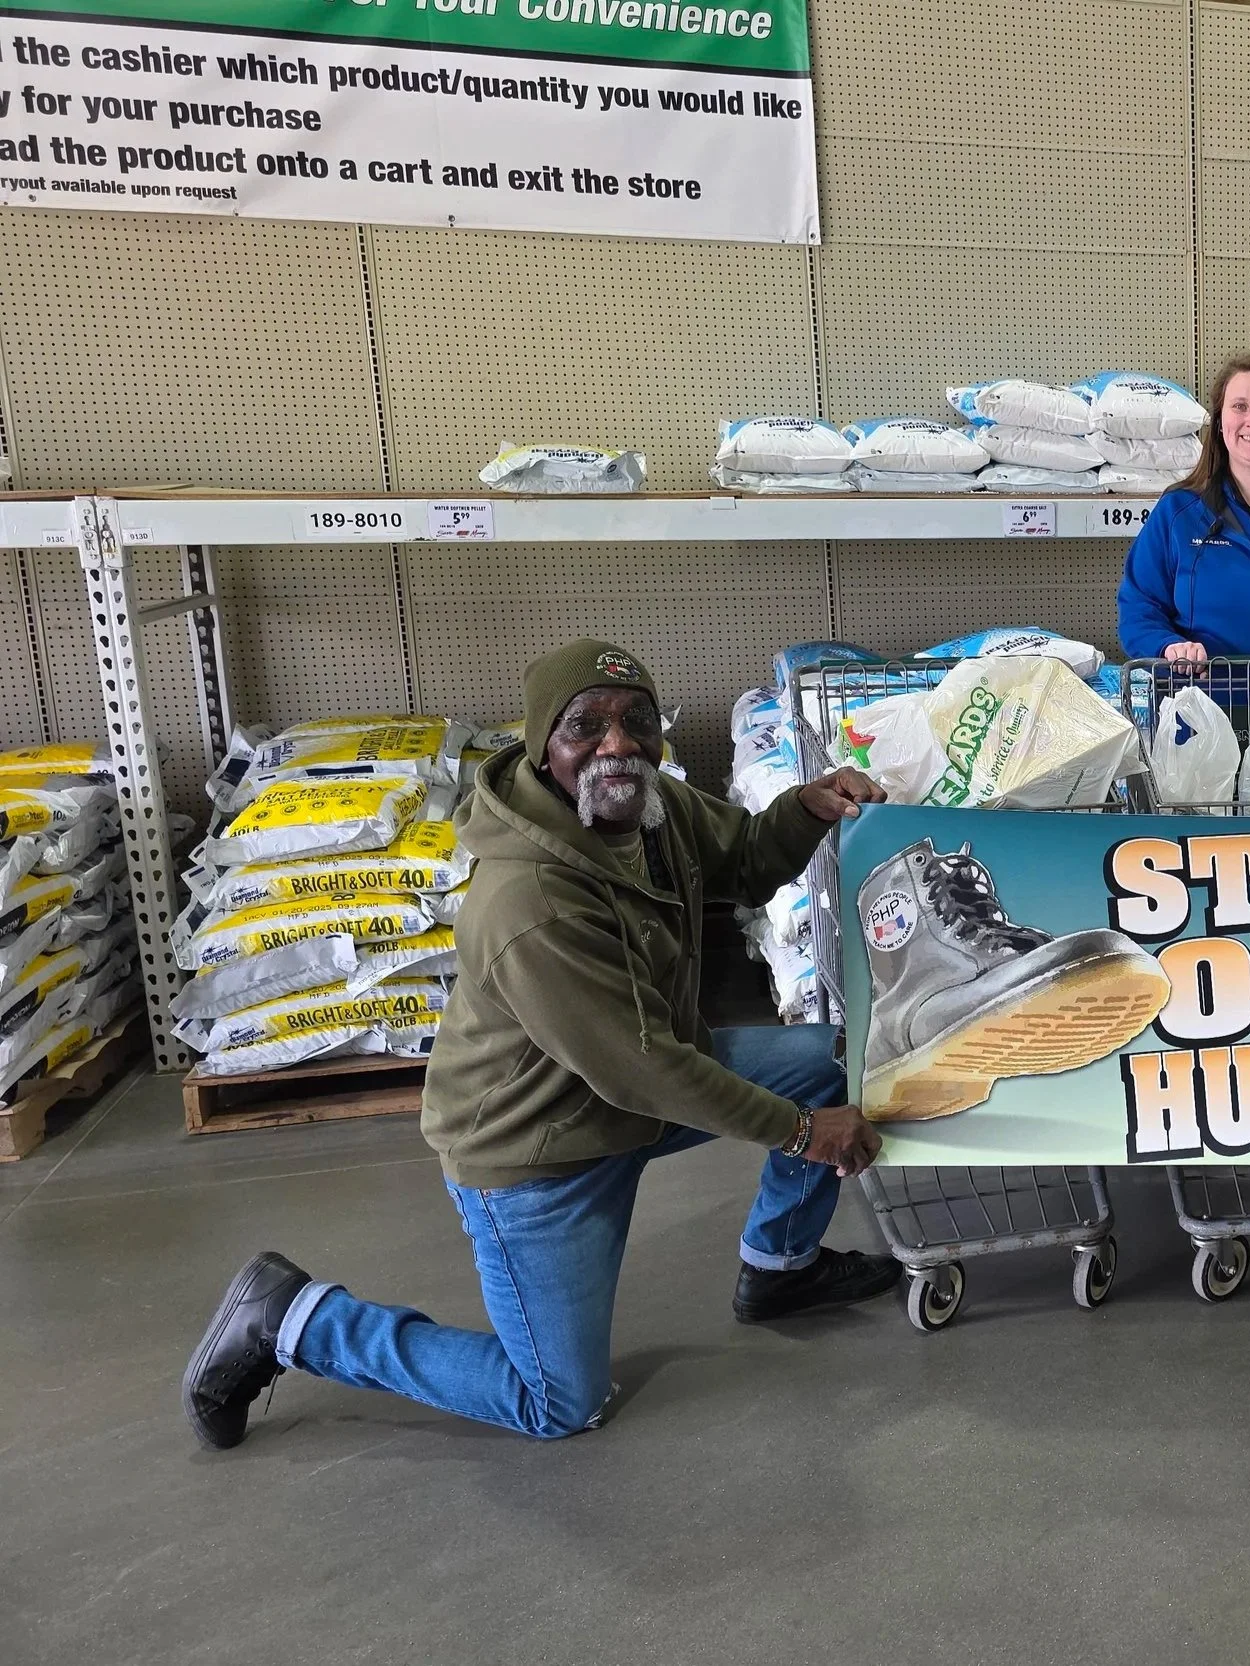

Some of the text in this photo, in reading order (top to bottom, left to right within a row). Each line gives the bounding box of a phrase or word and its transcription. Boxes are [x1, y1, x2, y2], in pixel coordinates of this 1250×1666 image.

[517, 0, 773, 39] Convenience
[13, 36, 70, 67] the
[82, 45, 206, 76] cashier
[217, 53, 318, 85] which
[329, 61, 588, 110] product/quantity
[597, 85, 649, 111] you
[659, 89, 744, 116] would
[754, 93, 802, 119] like
[21, 85, 322, 132] for your purchase
[50, 136, 107, 166] the
[118, 145, 247, 174] product
[256, 151, 328, 179] onto
[339, 158, 357, 182] a
[368, 158, 433, 185] cart
[442, 163, 498, 189] and
[508, 165, 563, 193] exit
[571, 169, 619, 196] the
[628, 173, 702, 200] store
[51, 177, 126, 195] available
[131, 183, 171, 198] upon
[175, 184, 238, 200] request
[310, 513, 402, 528] 189-8010
[605, 657, 631, 666] PHP
[291, 871, 395, 895] BRIGHT&SOFT
[893, 892, 912, 906] PEOPLE
[871, 899, 900, 927] PHP
[902, 921, 913, 938] CARE
[201, 946, 229, 963] Diamond
[369, 941, 399, 954] 40LB
[287, 999, 389, 1029] BRIGHT&SOFT
